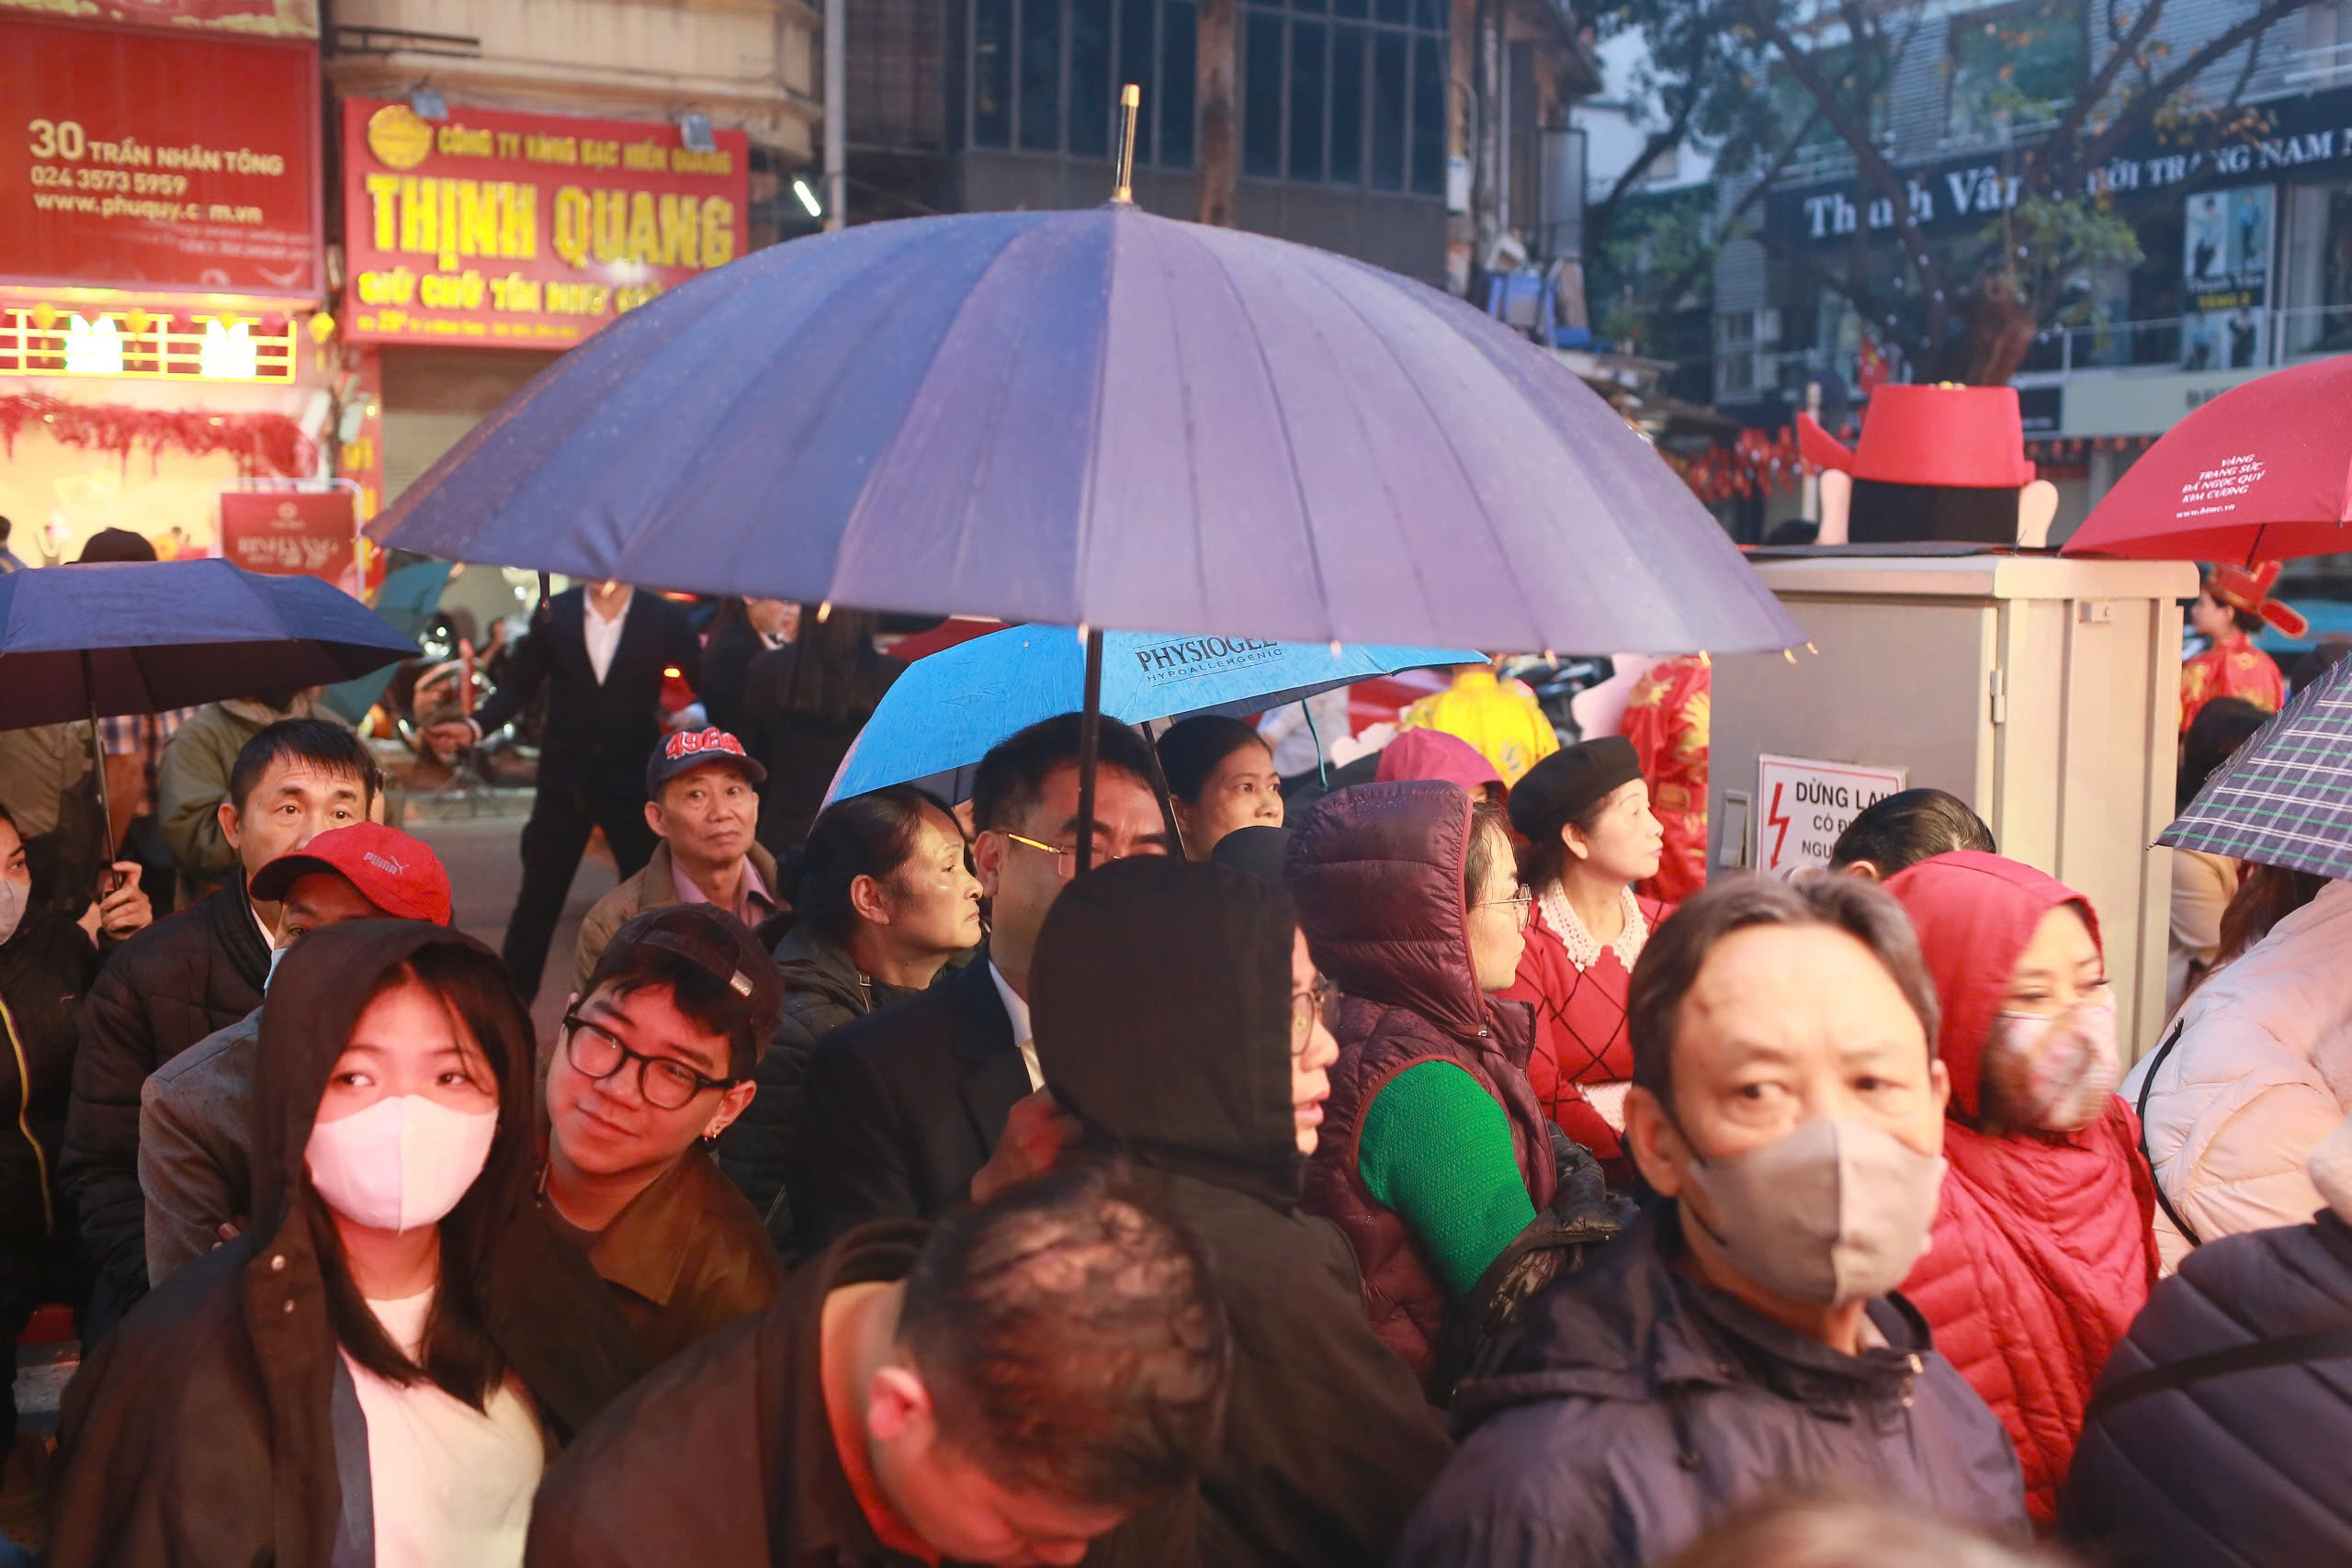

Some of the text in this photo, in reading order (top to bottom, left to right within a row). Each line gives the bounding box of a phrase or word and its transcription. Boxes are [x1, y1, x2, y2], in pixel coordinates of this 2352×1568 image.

[28, 118, 85, 161] 30
[156, 143, 220, 173] NHÂN
[223, 147, 285, 177] TÔNG
[2256, 130, 2335, 170] NAM
[31, 164, 74, 187] 024
[366, 172, 735, 271] THỊNH QUANG
[2199, 466, 2239, 481] TRANG
[2182, 491, 2206, 503] KIM
[1135, 635, 1279, 672] PHYSIOGEL
[1147, 648, 1283, 682] HYPOALLERGENIC
[1796, 777, 1849, 808] DỪNG
[1813, 812, 1834, 832] CÓ
[363, 852, 398, 874] PUMA
